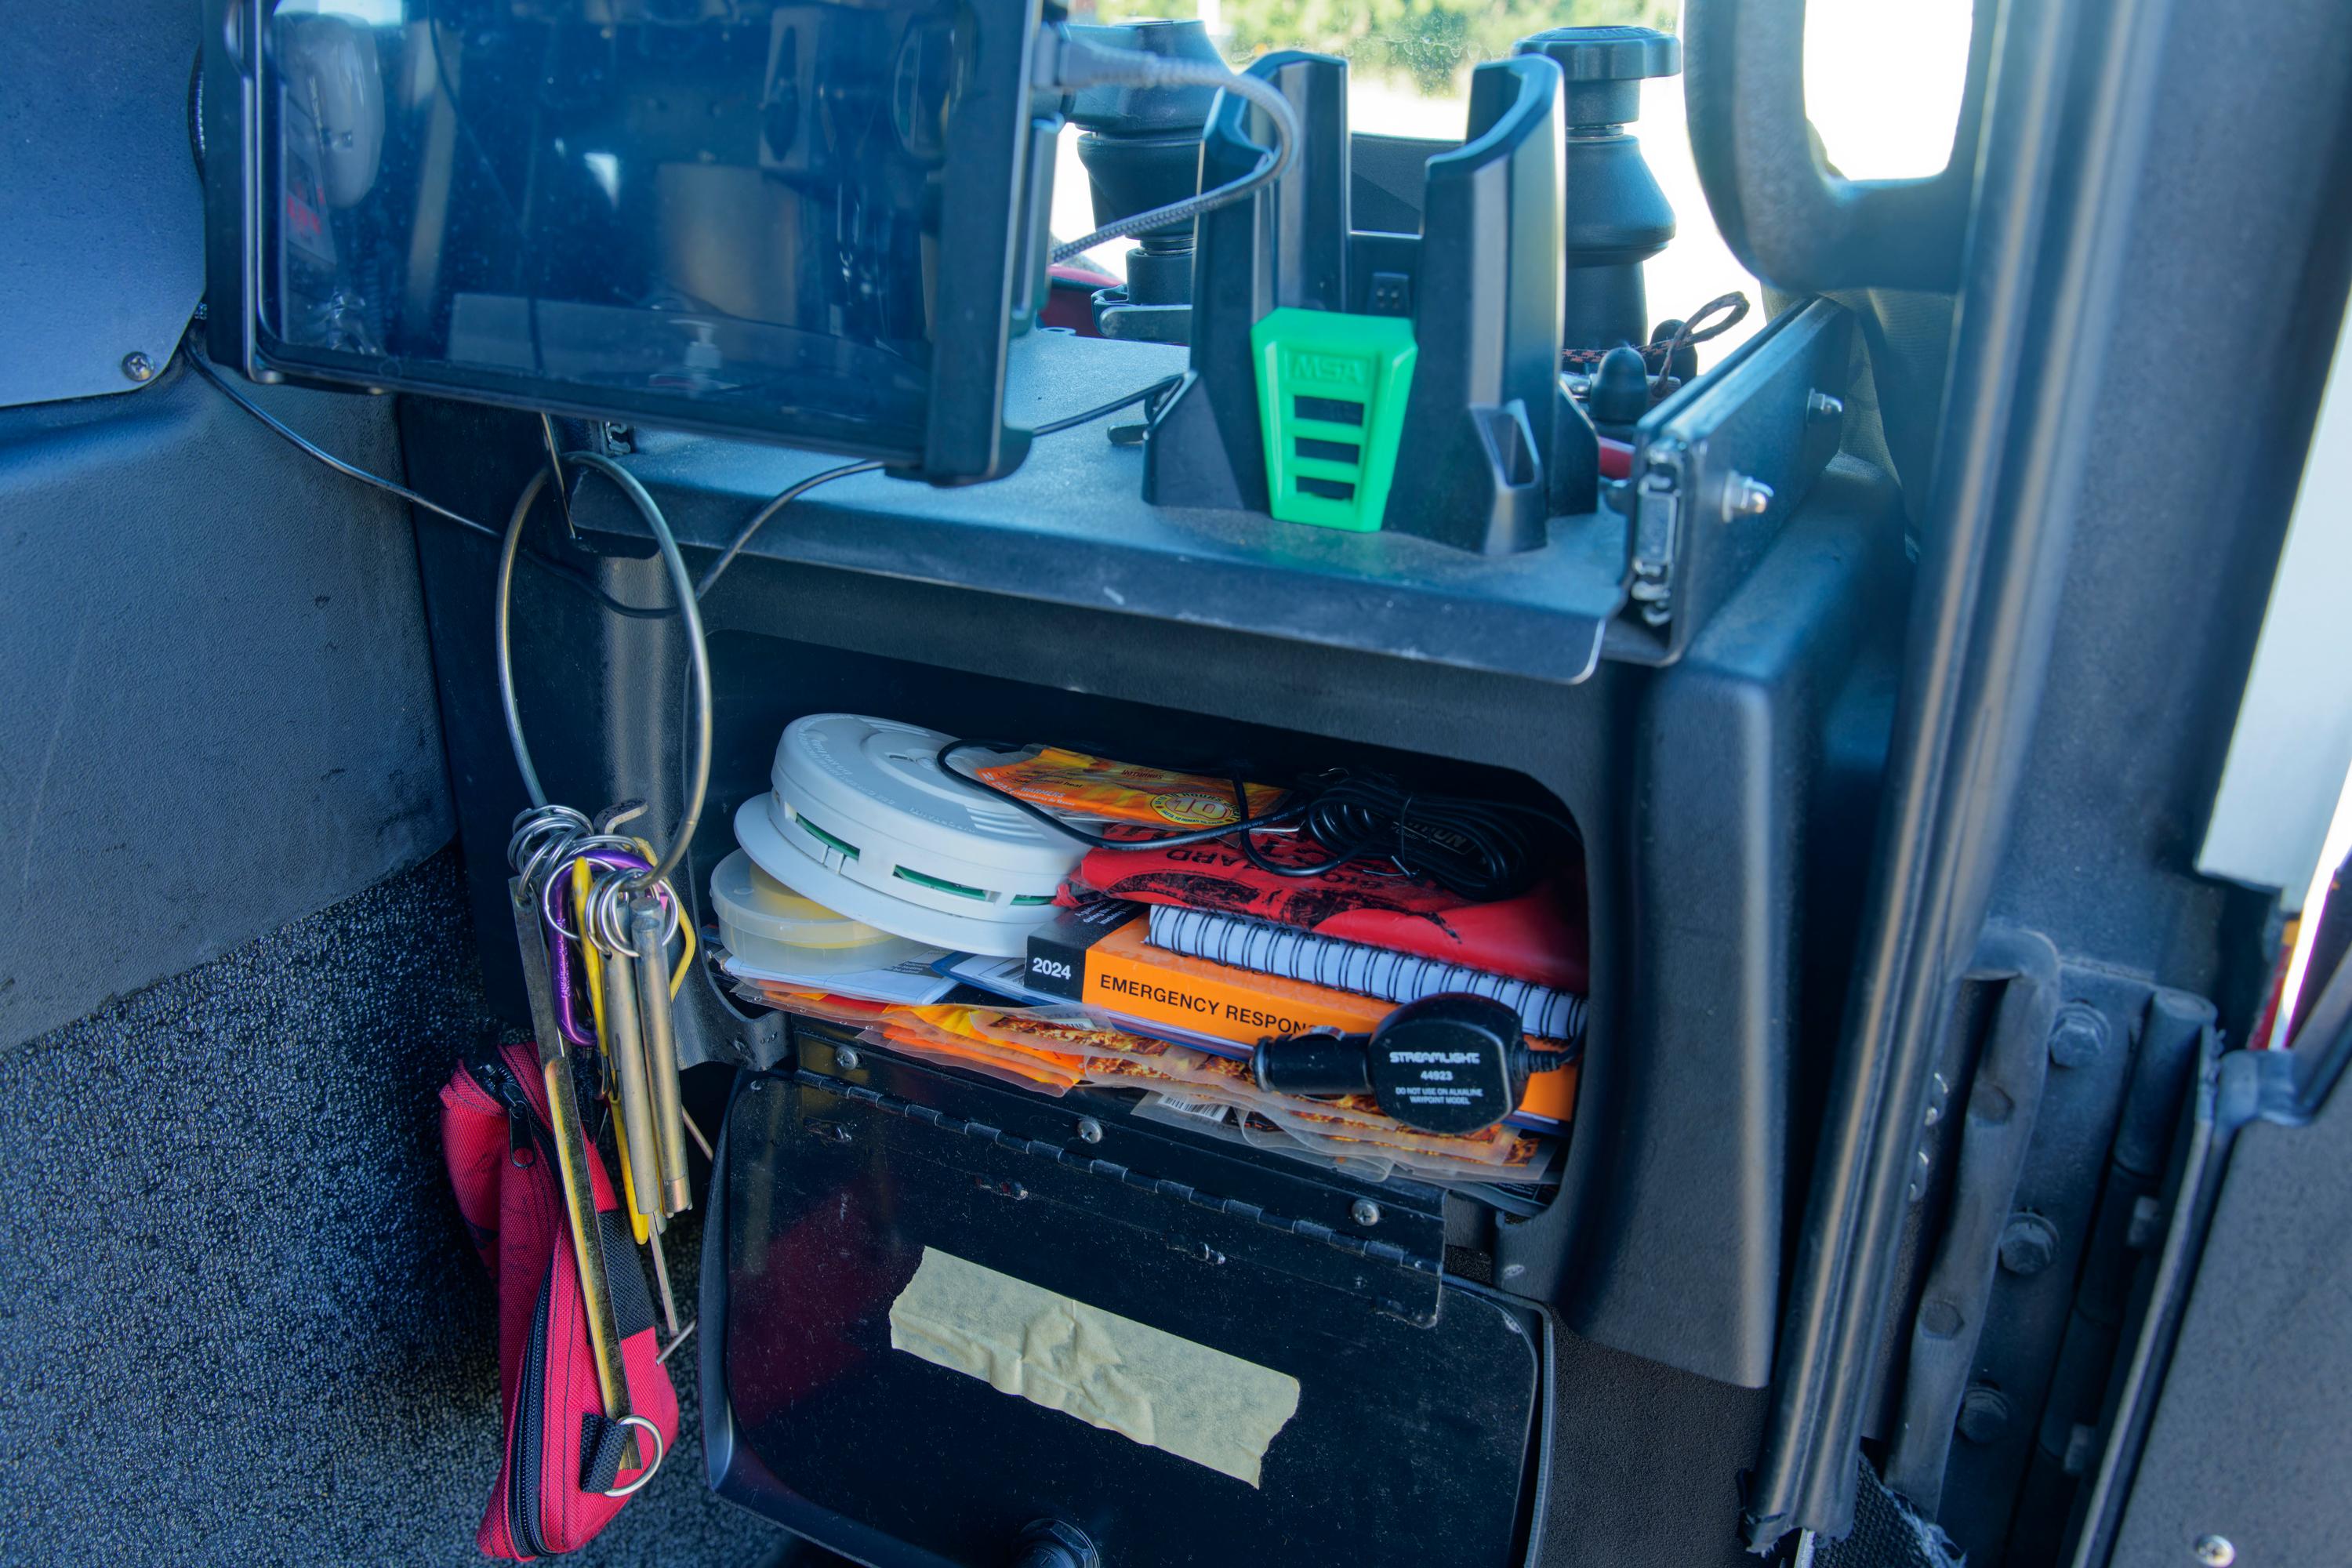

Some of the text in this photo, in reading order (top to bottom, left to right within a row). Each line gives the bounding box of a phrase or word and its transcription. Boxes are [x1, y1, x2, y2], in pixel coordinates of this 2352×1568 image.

[1294, 354, 1361, 383] MSA
[1174, 797, 1228, 820] 10
[1032, 956, 1072, 981] 2024
[1100, 974, 1316, 1036] EMERGENCY RESPON
[1389, 1051, 1480, 1065] STREAMLIGHT
[1421, 1070, 1454, 1081] 44923
[1410, 1095, 1445, 1104] WAYPOINT
[1449, 1088, 1483, 1097] ALKALINE
